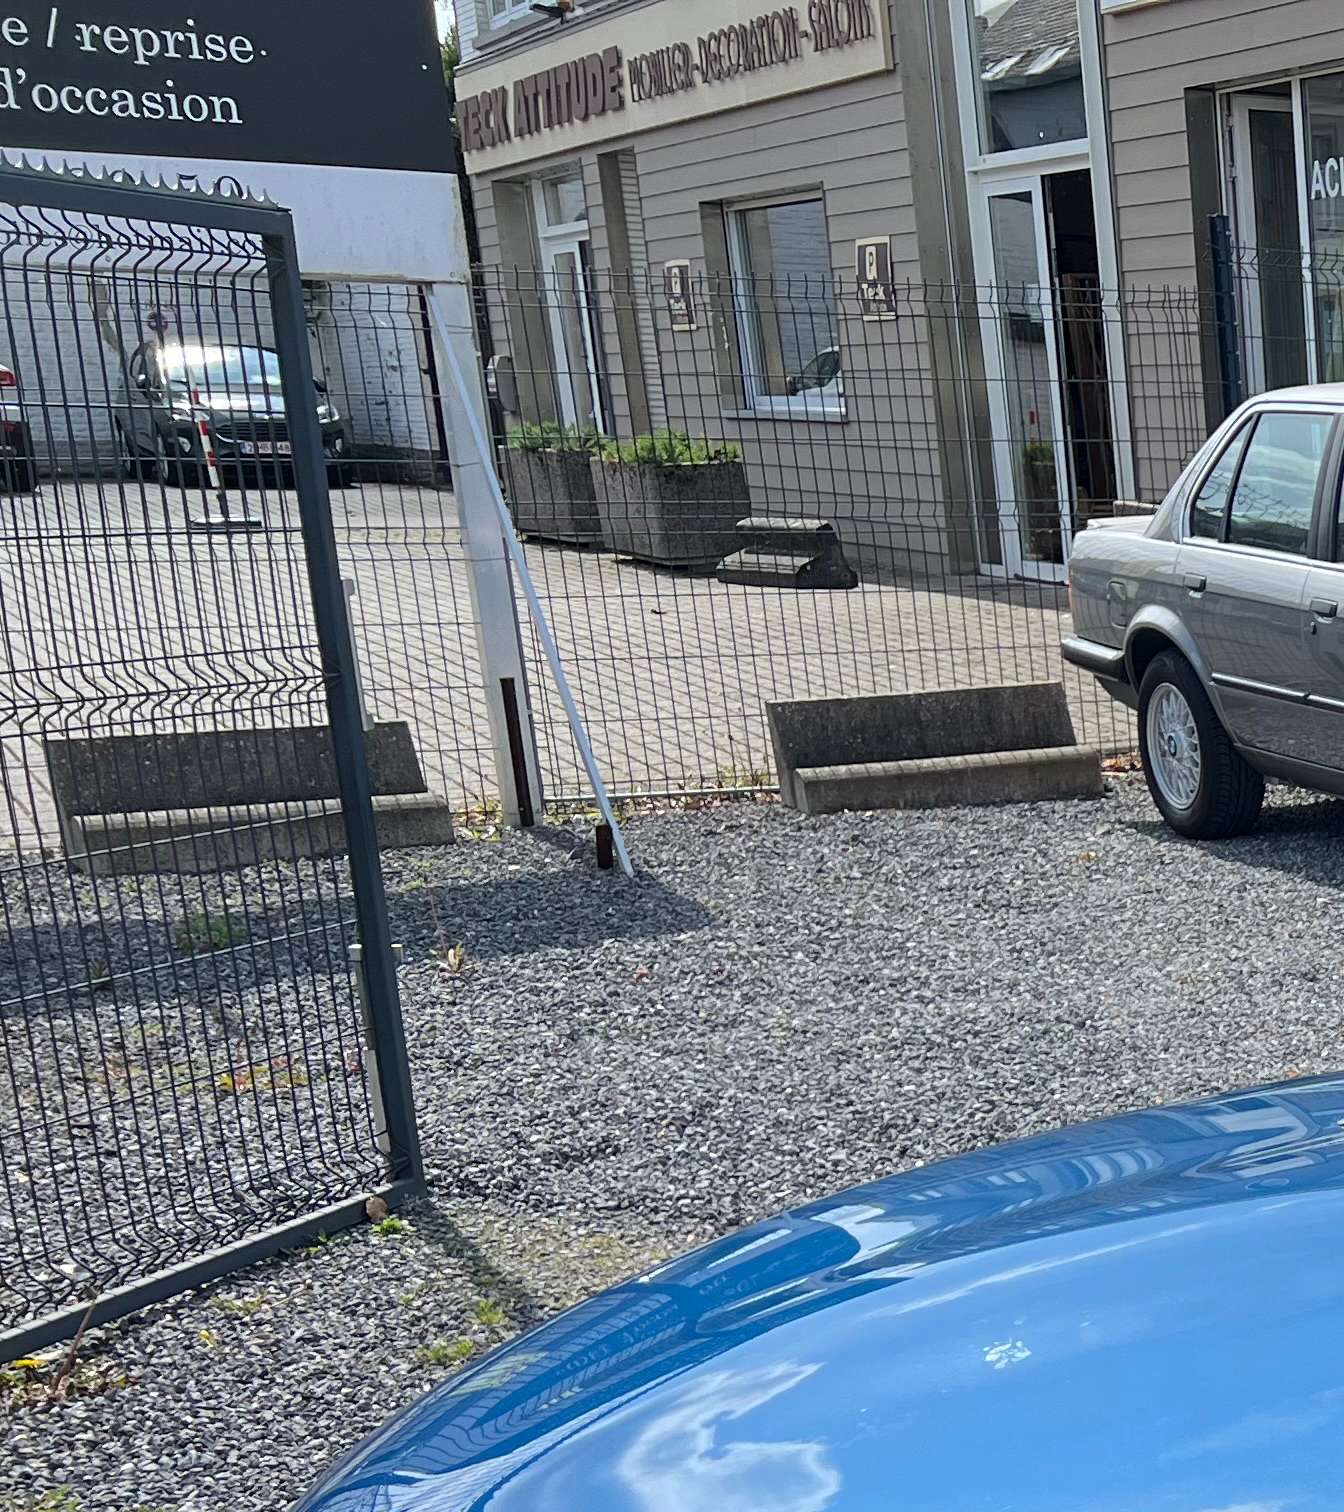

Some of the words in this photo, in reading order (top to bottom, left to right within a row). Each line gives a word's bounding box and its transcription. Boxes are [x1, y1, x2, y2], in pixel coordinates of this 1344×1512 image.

[77, 18, 255, 66] reprise
[456, 85, 511, 152] TECK
[513, 45, 625, 139] ATTITUDE
